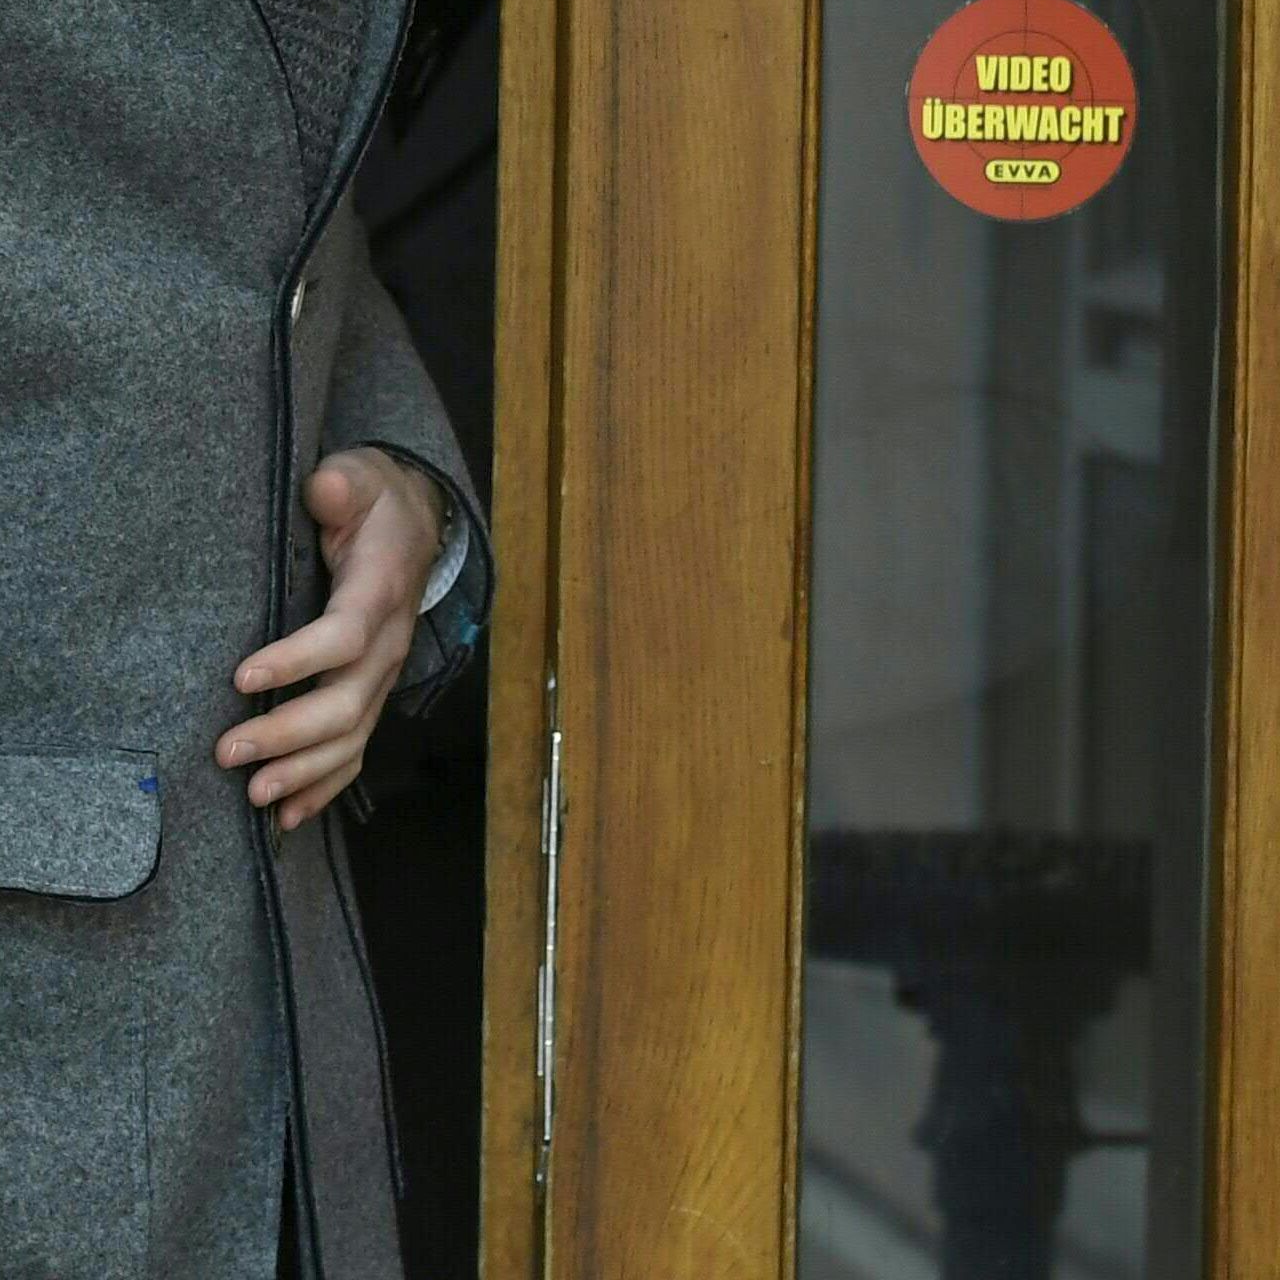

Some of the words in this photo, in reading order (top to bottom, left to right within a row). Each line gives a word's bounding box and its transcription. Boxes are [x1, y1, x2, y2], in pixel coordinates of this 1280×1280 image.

[976, 55, 1071, 93] VIDEO
[922, 98, 1124, 143] ÜBERWACHT
[993, 163, 1052, 179] EVVA
